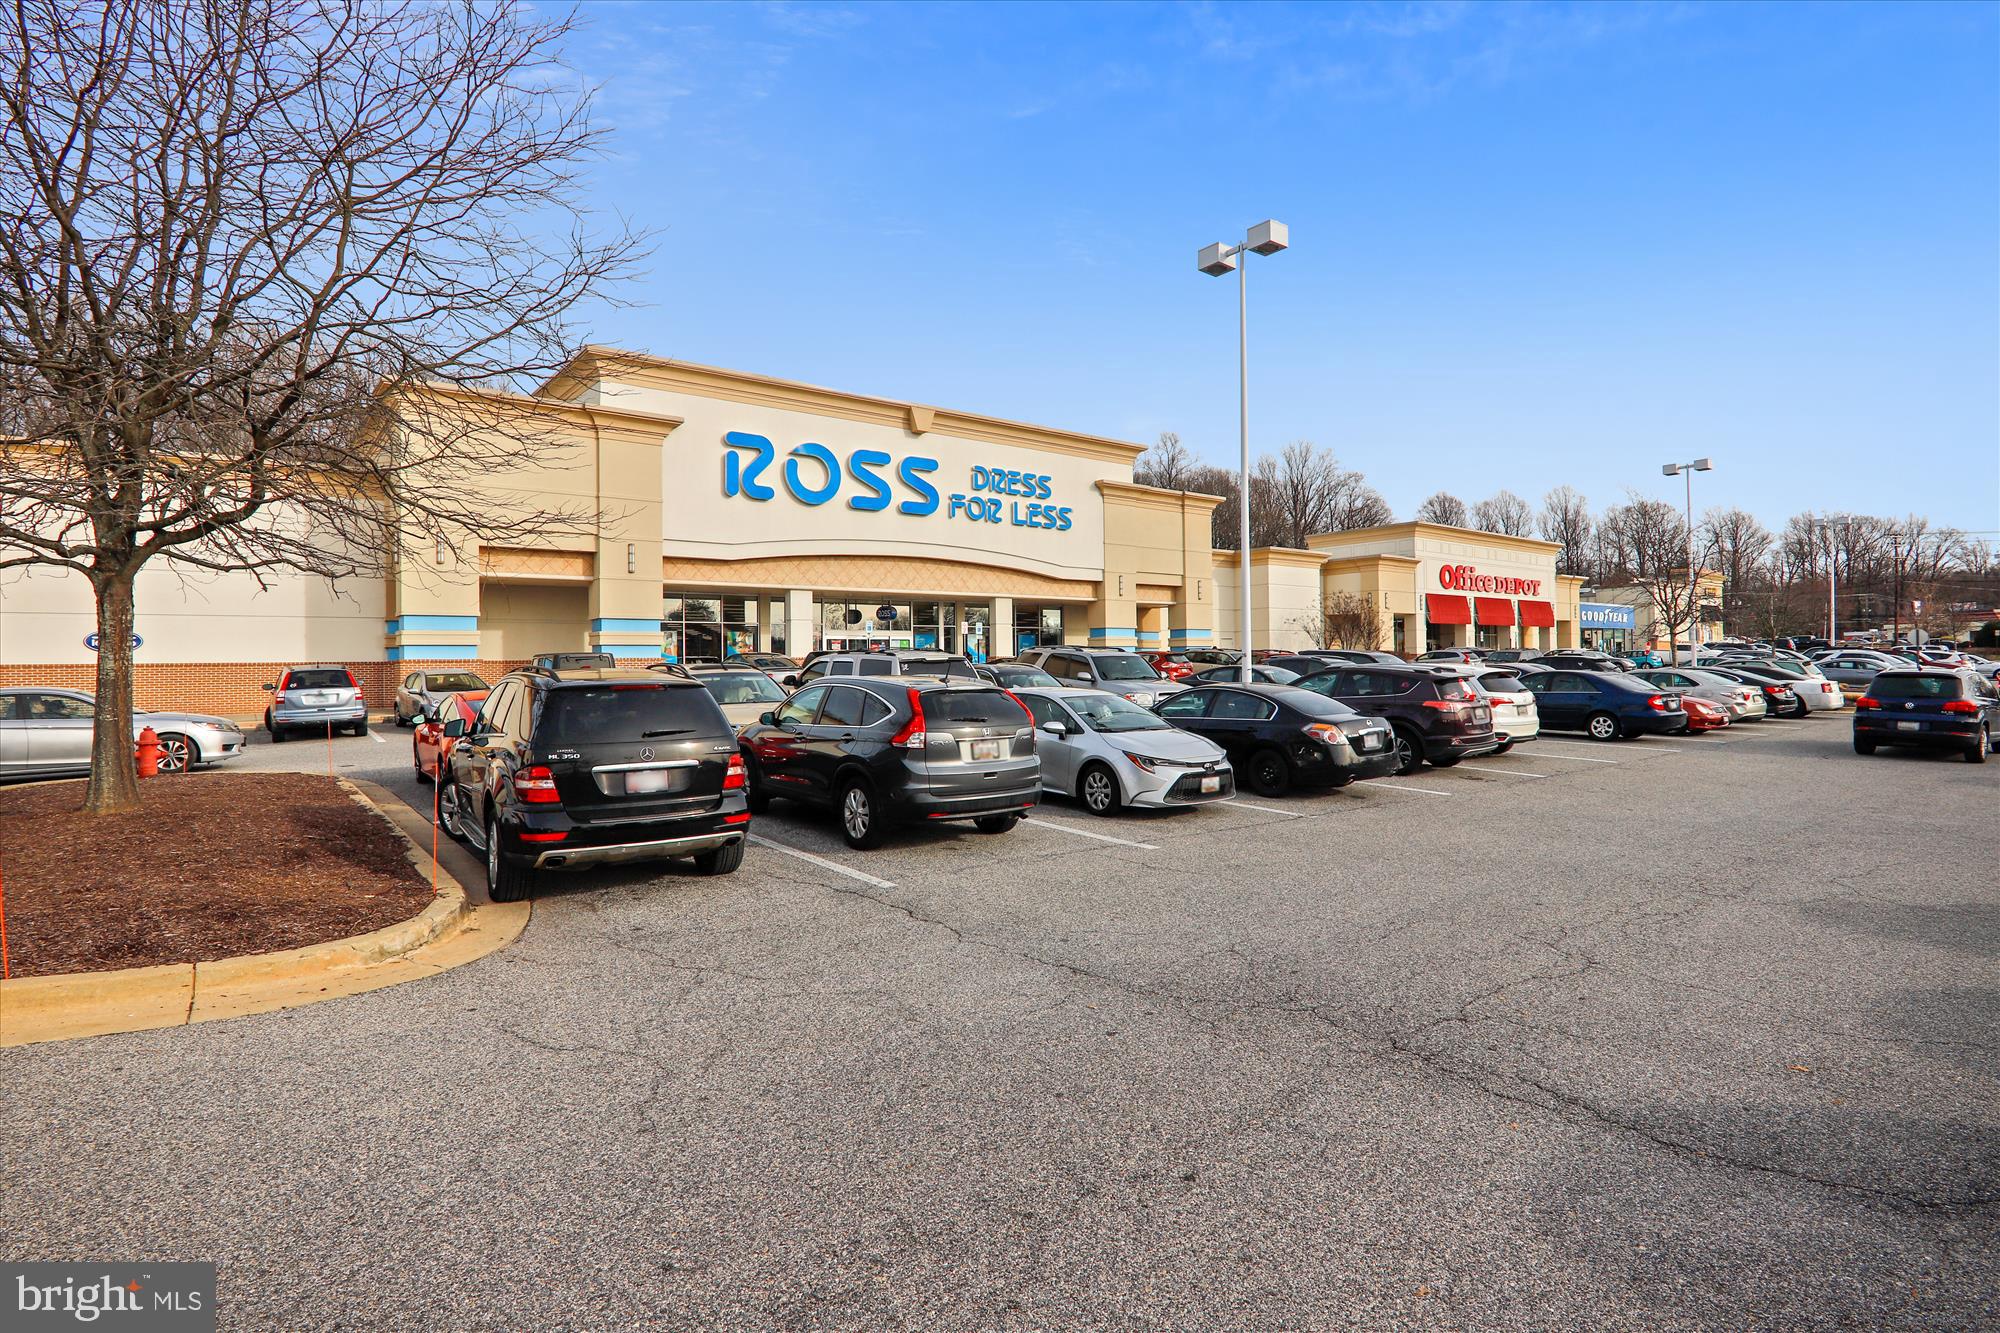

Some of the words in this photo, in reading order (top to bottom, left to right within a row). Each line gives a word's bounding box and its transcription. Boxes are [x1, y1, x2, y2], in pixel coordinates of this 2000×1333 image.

[724, 431, 940, 516] ROSS
[972, 465, 1052, 500] DRESS
[950, 493, 1003, 524] FOR
[1012, 501, 1073, 531] LESS
[1439, 564, 1494, 593] Office
[1495, 576, 1541, 596] DEPOT
[1581, 608, 1628, 624] GOODYEAR
